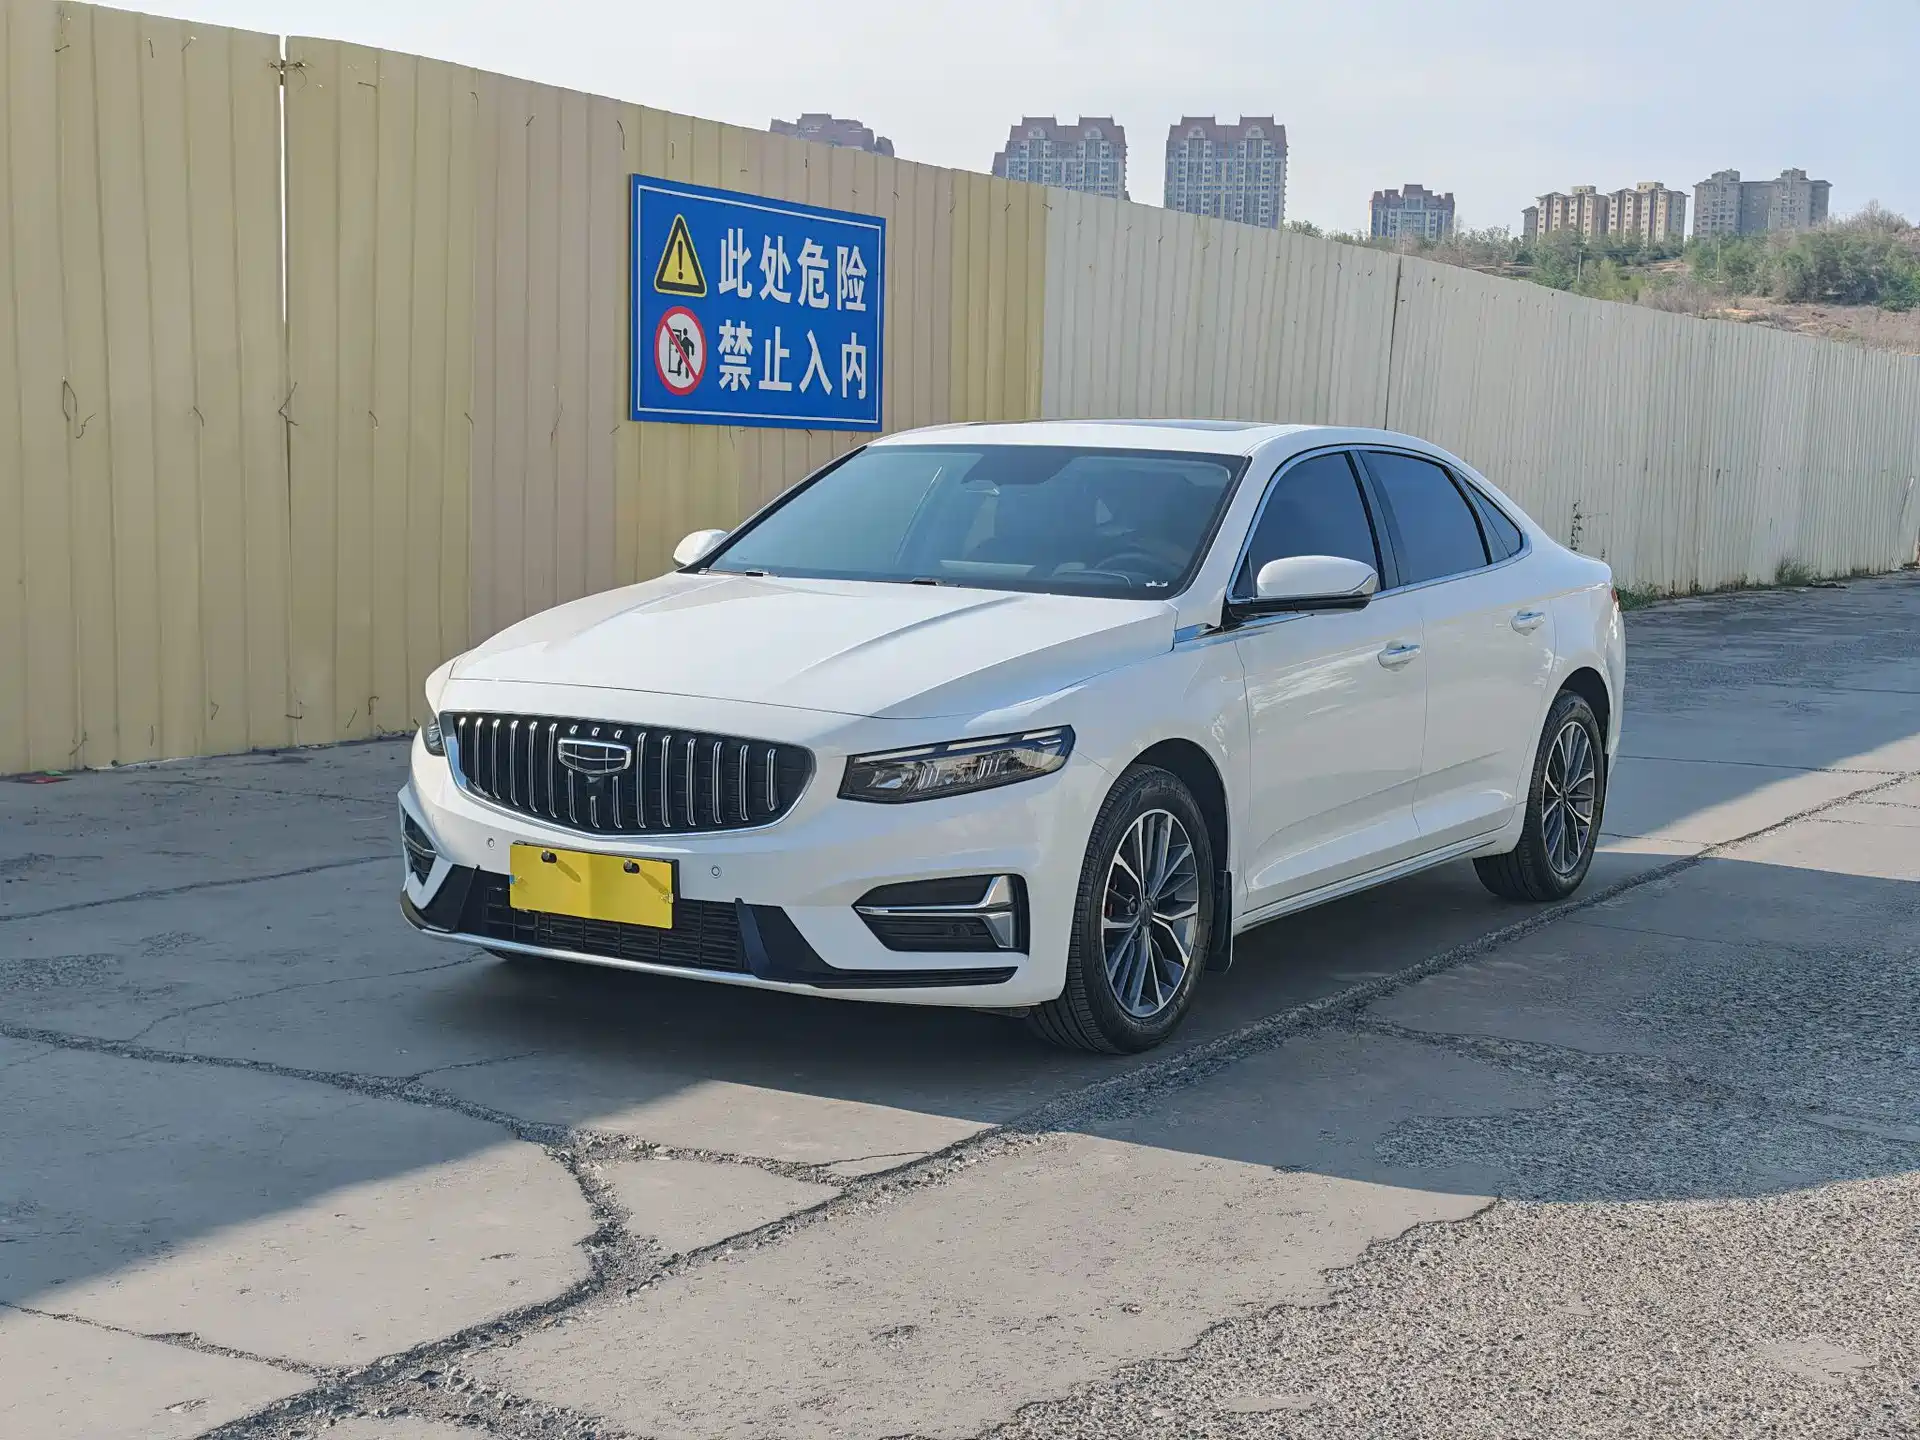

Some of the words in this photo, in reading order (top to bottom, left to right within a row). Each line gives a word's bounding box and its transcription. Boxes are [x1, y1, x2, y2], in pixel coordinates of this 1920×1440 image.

[718, 228, 868, 312] 此处危险
[718, 319, 868, 400] 禁止入内
